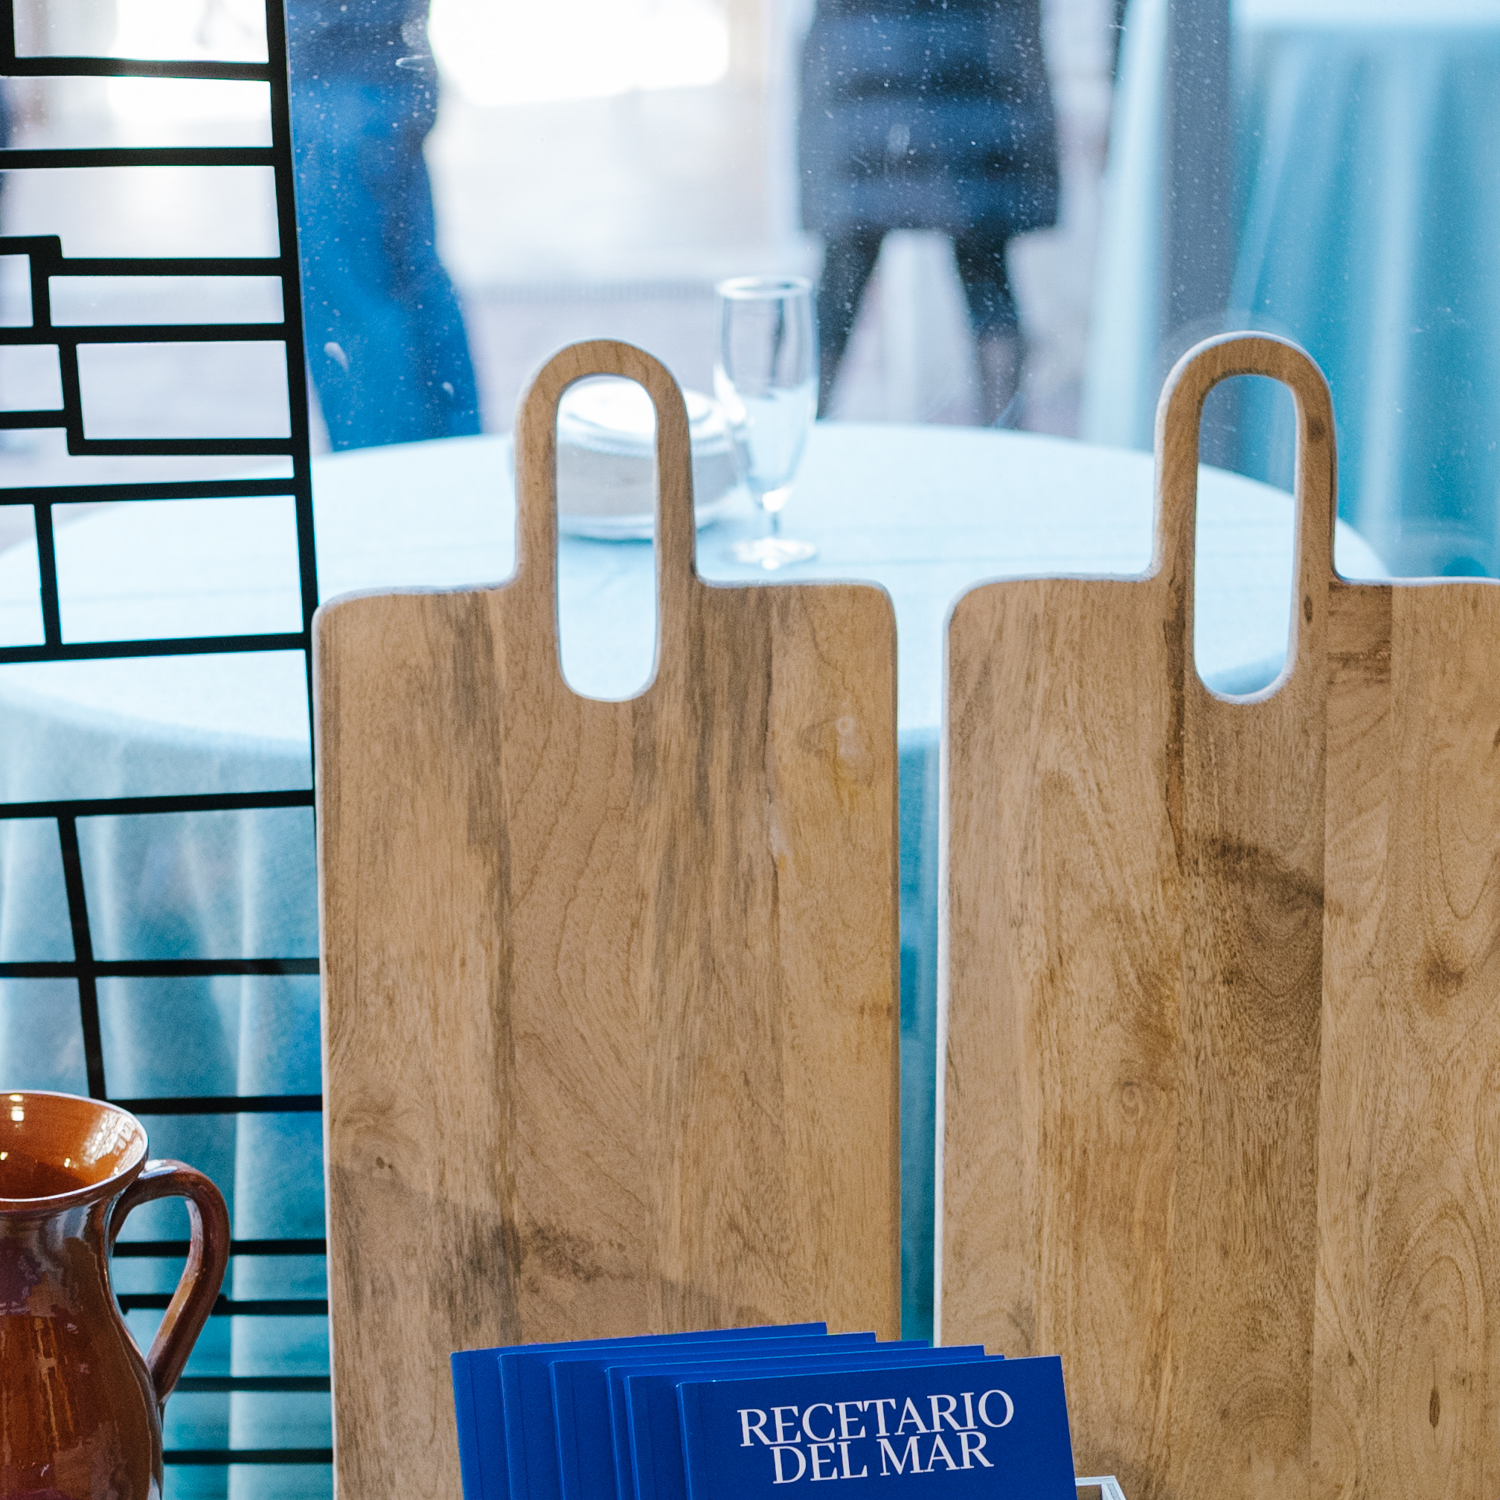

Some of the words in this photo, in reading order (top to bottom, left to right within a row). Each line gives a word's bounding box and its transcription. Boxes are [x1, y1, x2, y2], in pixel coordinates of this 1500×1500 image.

[737, 1388, 1015, 1448] RECETARIO
[769, 1437, 868, 1486] DEL
[878, 1430, 995, 1478] MAR
